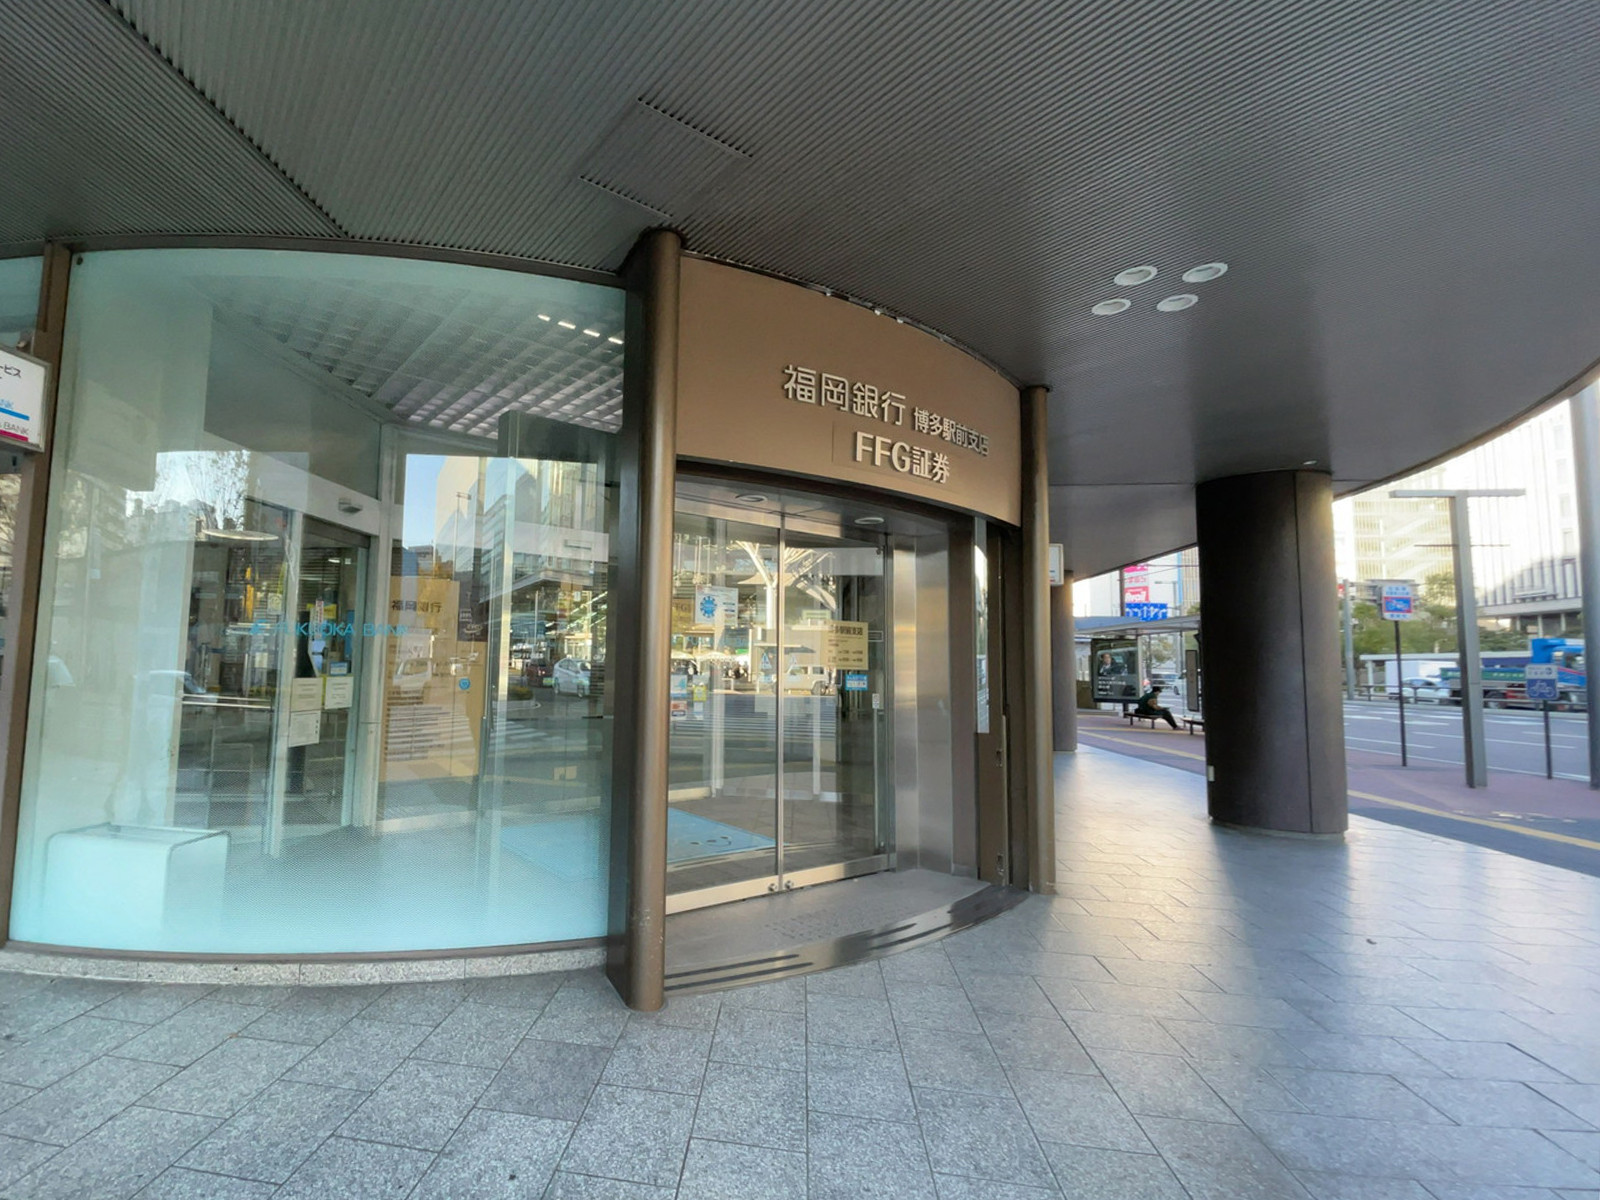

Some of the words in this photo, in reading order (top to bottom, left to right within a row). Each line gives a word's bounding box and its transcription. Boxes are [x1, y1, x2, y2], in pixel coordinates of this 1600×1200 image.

[783, 365, 906, 426] 福岡銀行
[913, 407, 990, 457] 博多駅前支店
[855, 431, 950, 484] FFG証券
